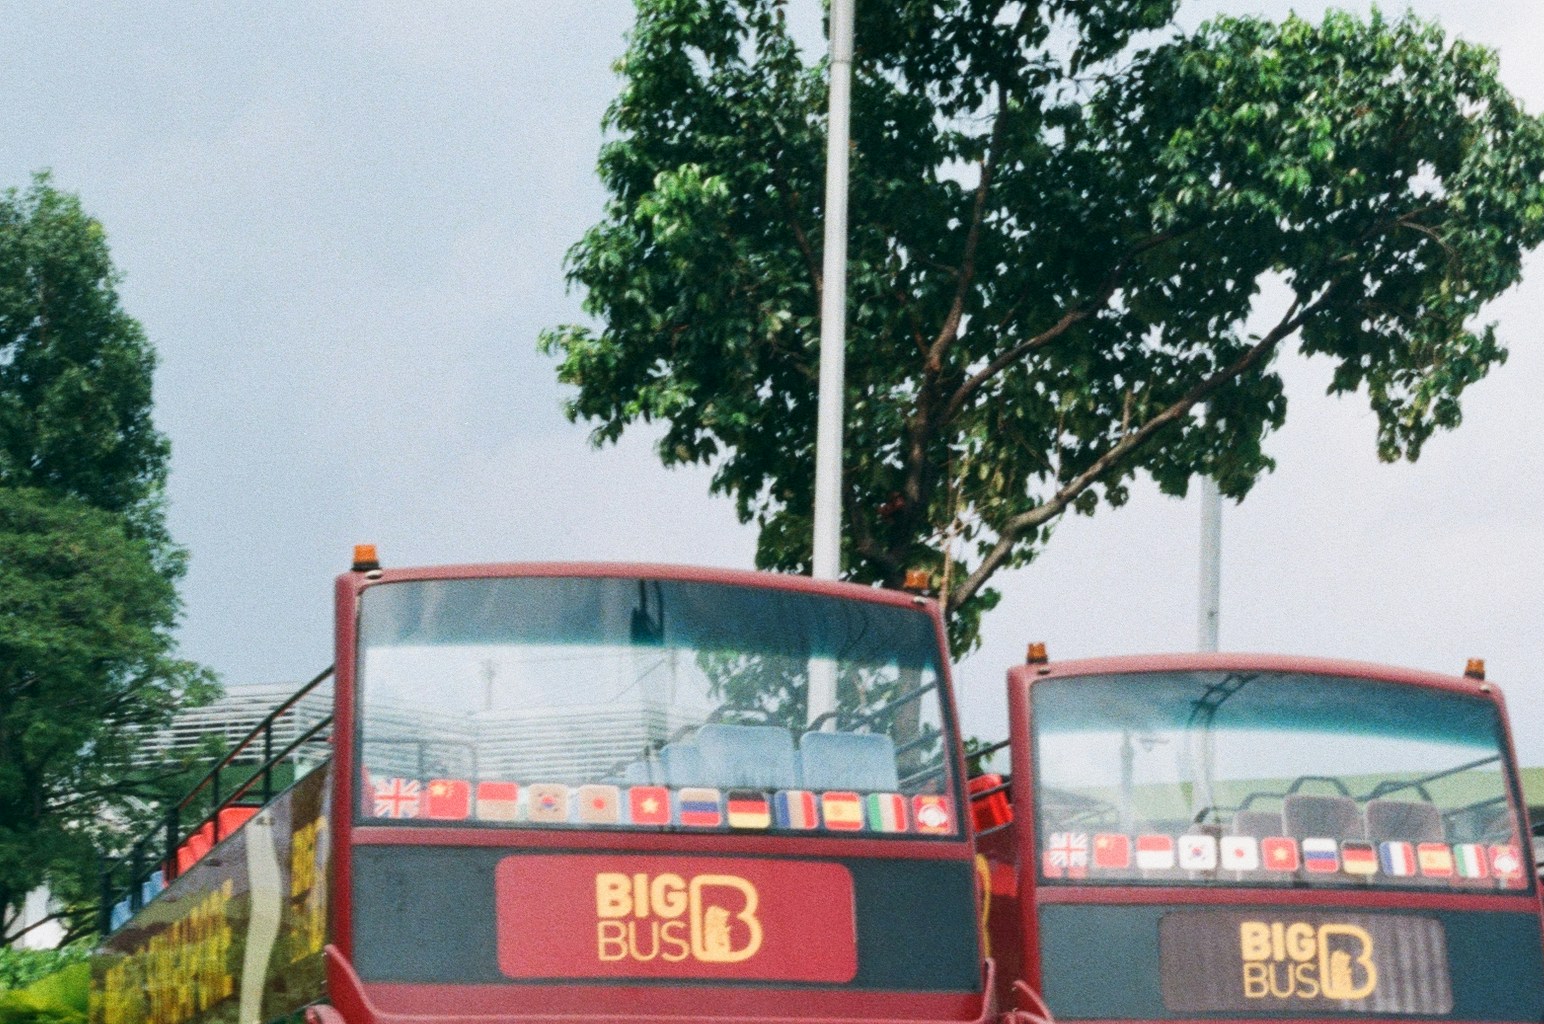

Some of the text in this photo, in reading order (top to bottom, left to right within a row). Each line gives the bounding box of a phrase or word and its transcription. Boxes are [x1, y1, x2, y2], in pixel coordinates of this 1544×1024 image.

[596, 873, 688, 917] BIG
[598, 920, 689, 962] BUS
[1241, 922, 1316, 962] BIG
[1244, 963, 1320, 998] BUS
